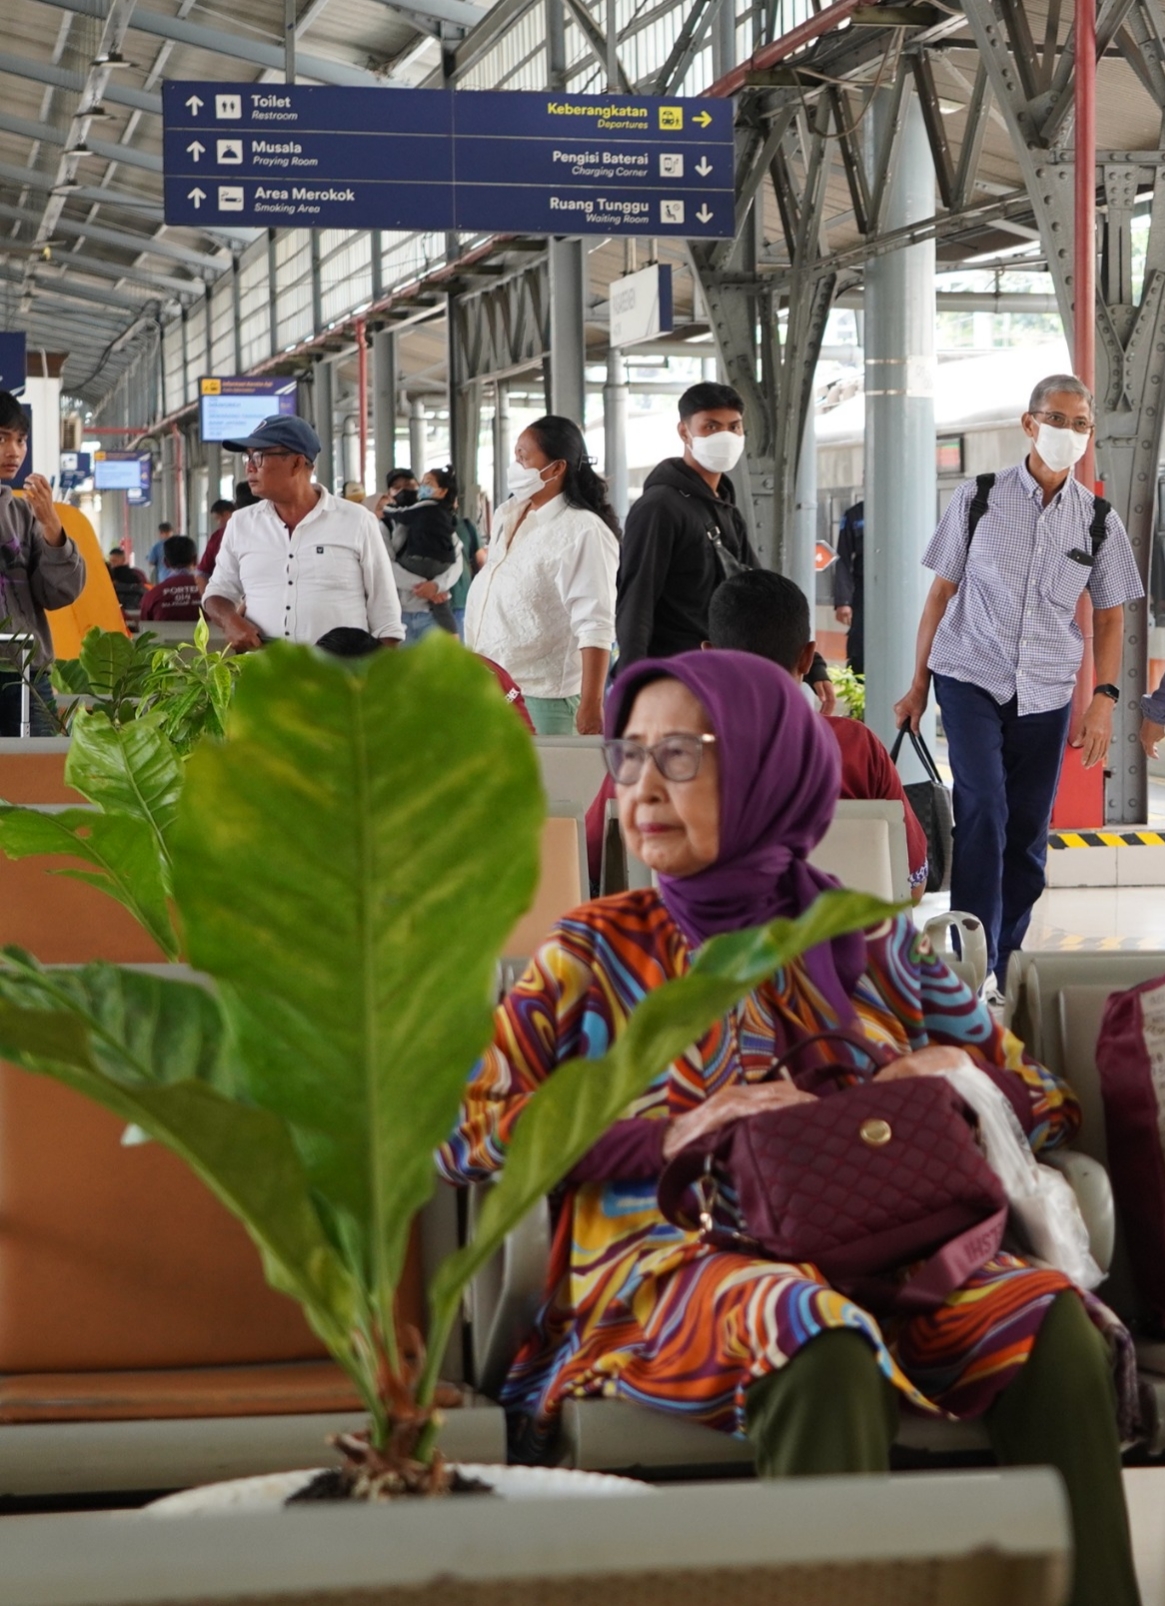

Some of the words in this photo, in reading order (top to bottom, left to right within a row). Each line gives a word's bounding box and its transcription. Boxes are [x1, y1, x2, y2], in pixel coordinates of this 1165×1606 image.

[251, 94, 291, 108] Toilet
[252, 110, 298, 120] Restroom
[547, 103, 648, 119] Keberangkatan
[597, 119, 649, 129] Departures
[252, 141, 302, 153] Musala
[253, 155, 289, 168] Praying
[290, 157, 319, 166] Room
[552, 150, 599, 165] Pengisi
[602, 152, 649, 165] Baterai
[571, 165, 614, 178] Charging
[615, 167, 648, 177] Corner
[254, 186, 289, 200] Area
[292, 187, 355, 202] Merokok
[254, 202, 296, 215] Smoking
[297, 204, 321, 214] Area
[549, 197, 594, 213] Ruang
[596, 198, 649, 214] Tunggu
[585, 213, 622, 225] Waiting
[622, 215, 650, 224] Room
